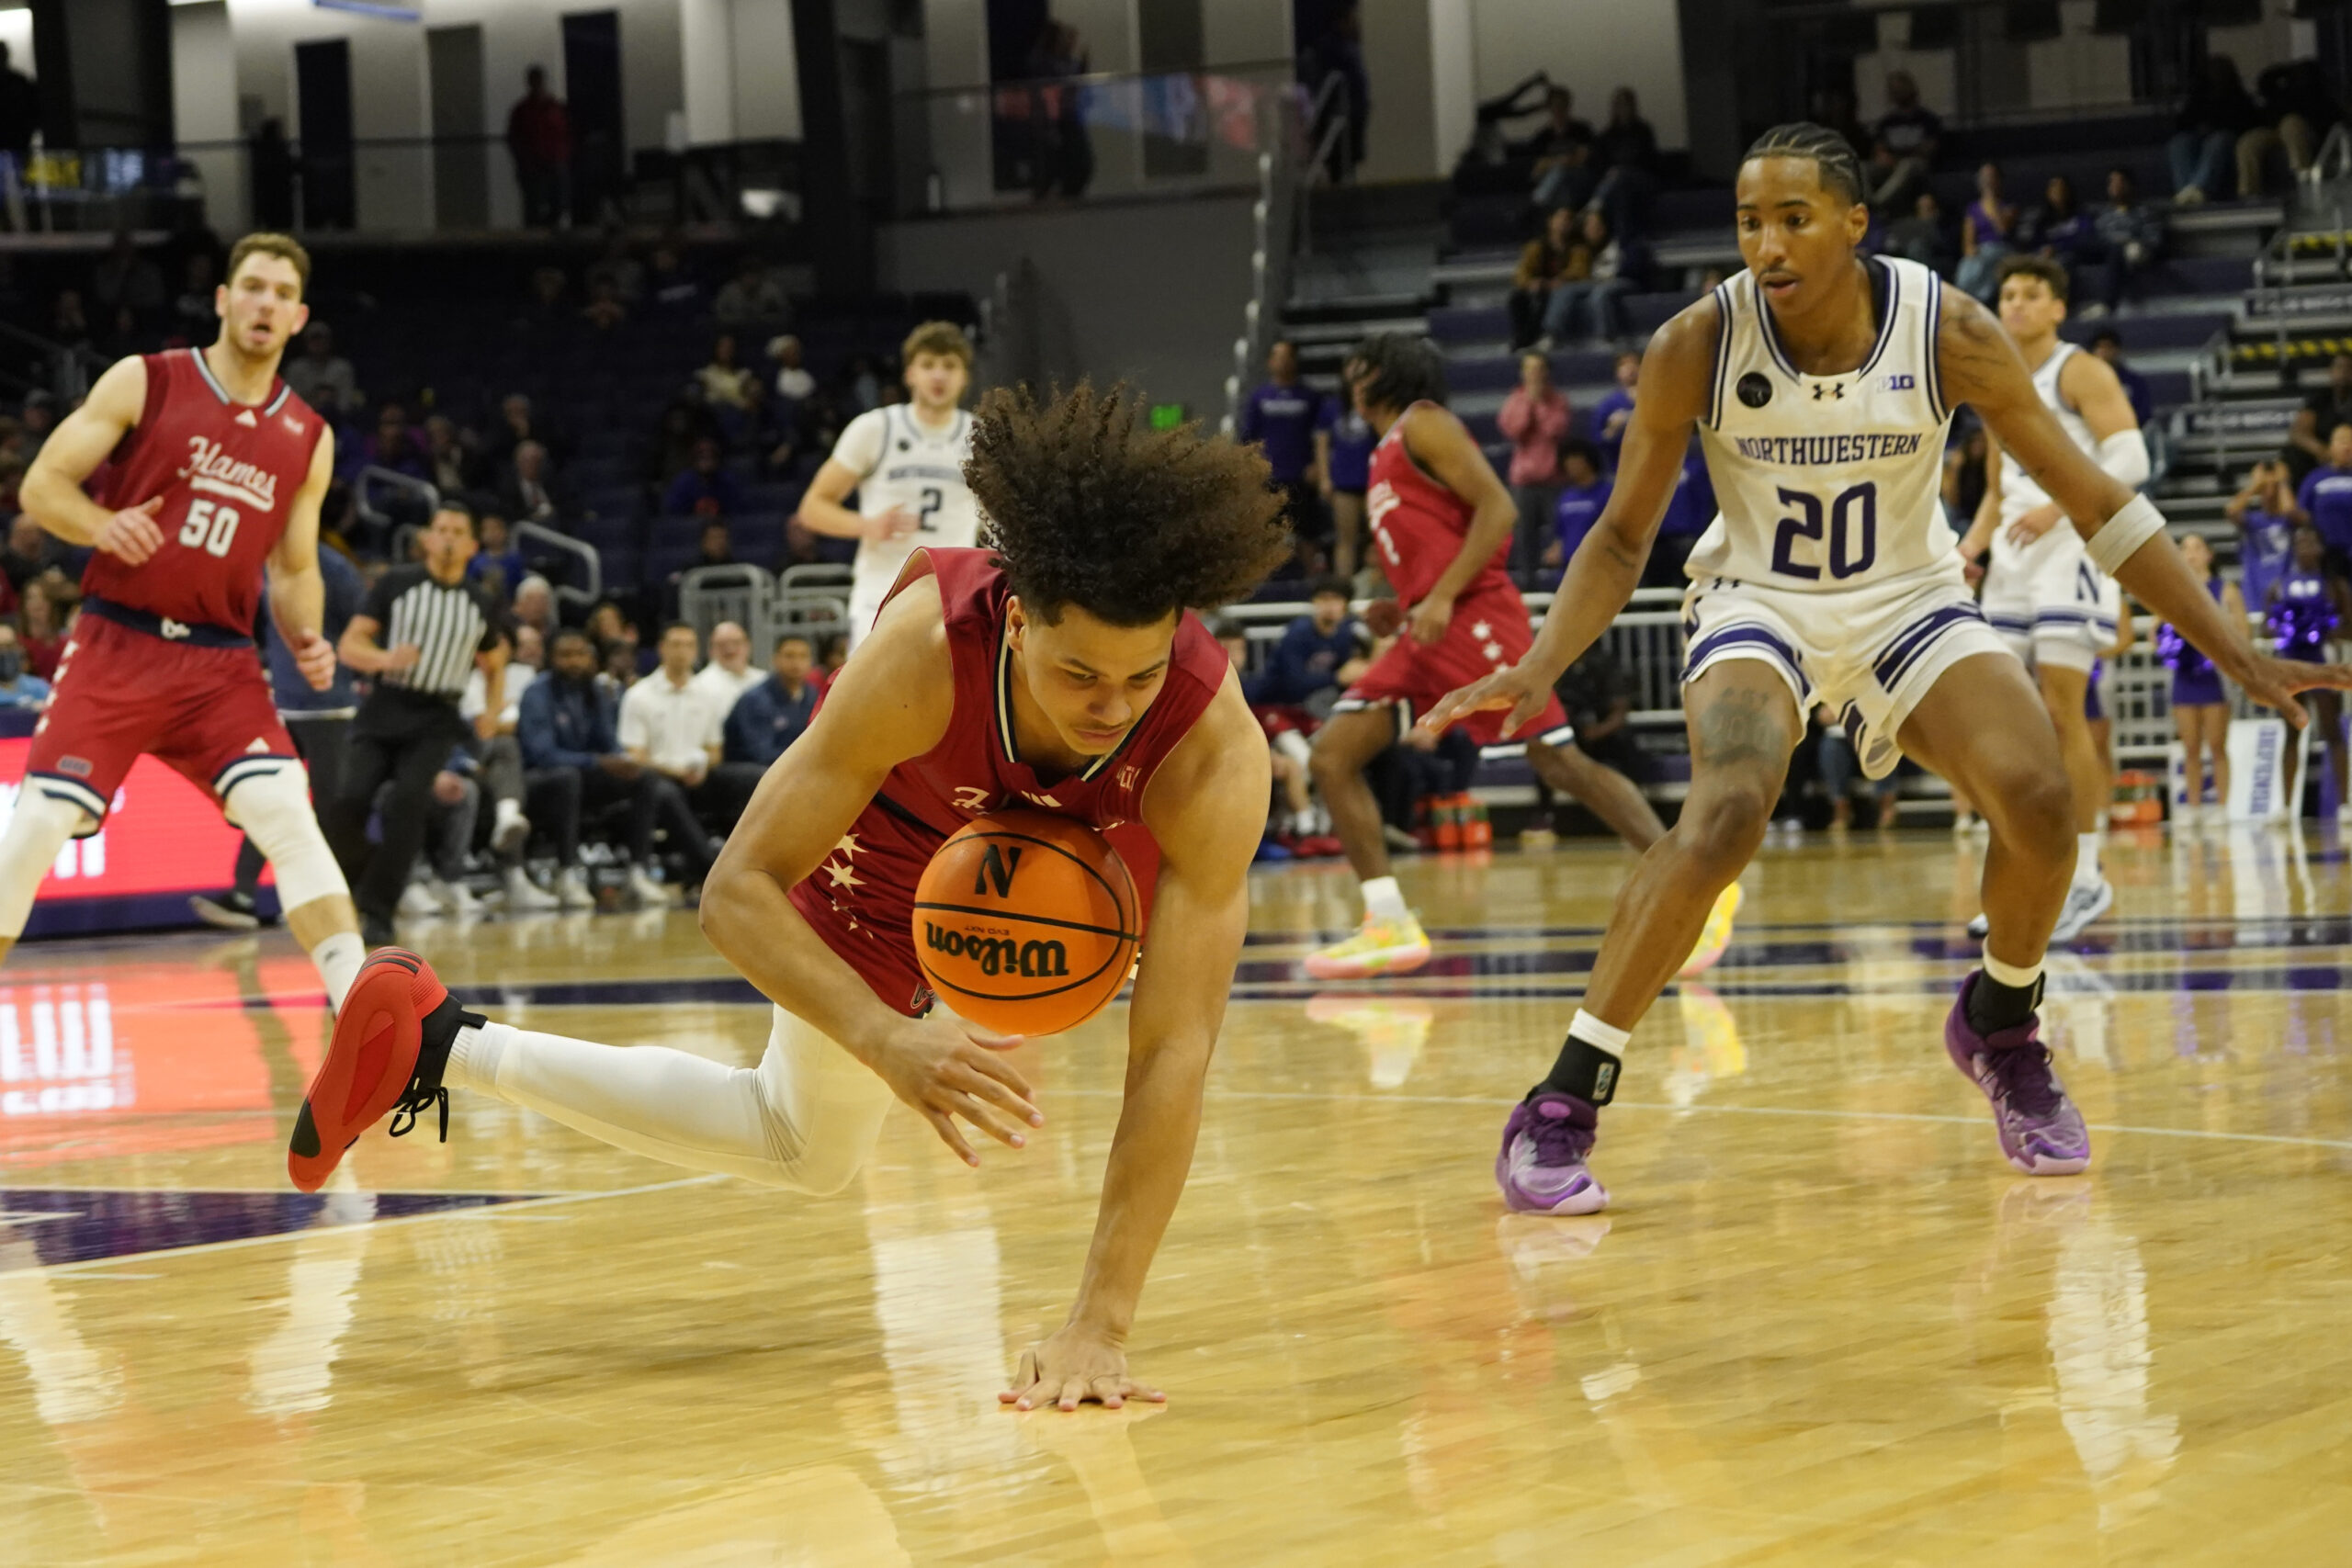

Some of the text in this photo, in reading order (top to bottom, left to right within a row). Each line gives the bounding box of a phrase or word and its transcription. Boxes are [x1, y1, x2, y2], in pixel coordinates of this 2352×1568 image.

[177, 435, 277, 507] Flames
[1735, 433, 1923, 466] NORTHWESTERN
[178, 498, 240, 558] 50
[920, 486, 943, 532] 2
[1770, 480, 1876, 581] 20
[974, 843, 1023, 898] N
[925, 921, 1069, 977] Wilson
[988, 928, 1010, 936] EVO
